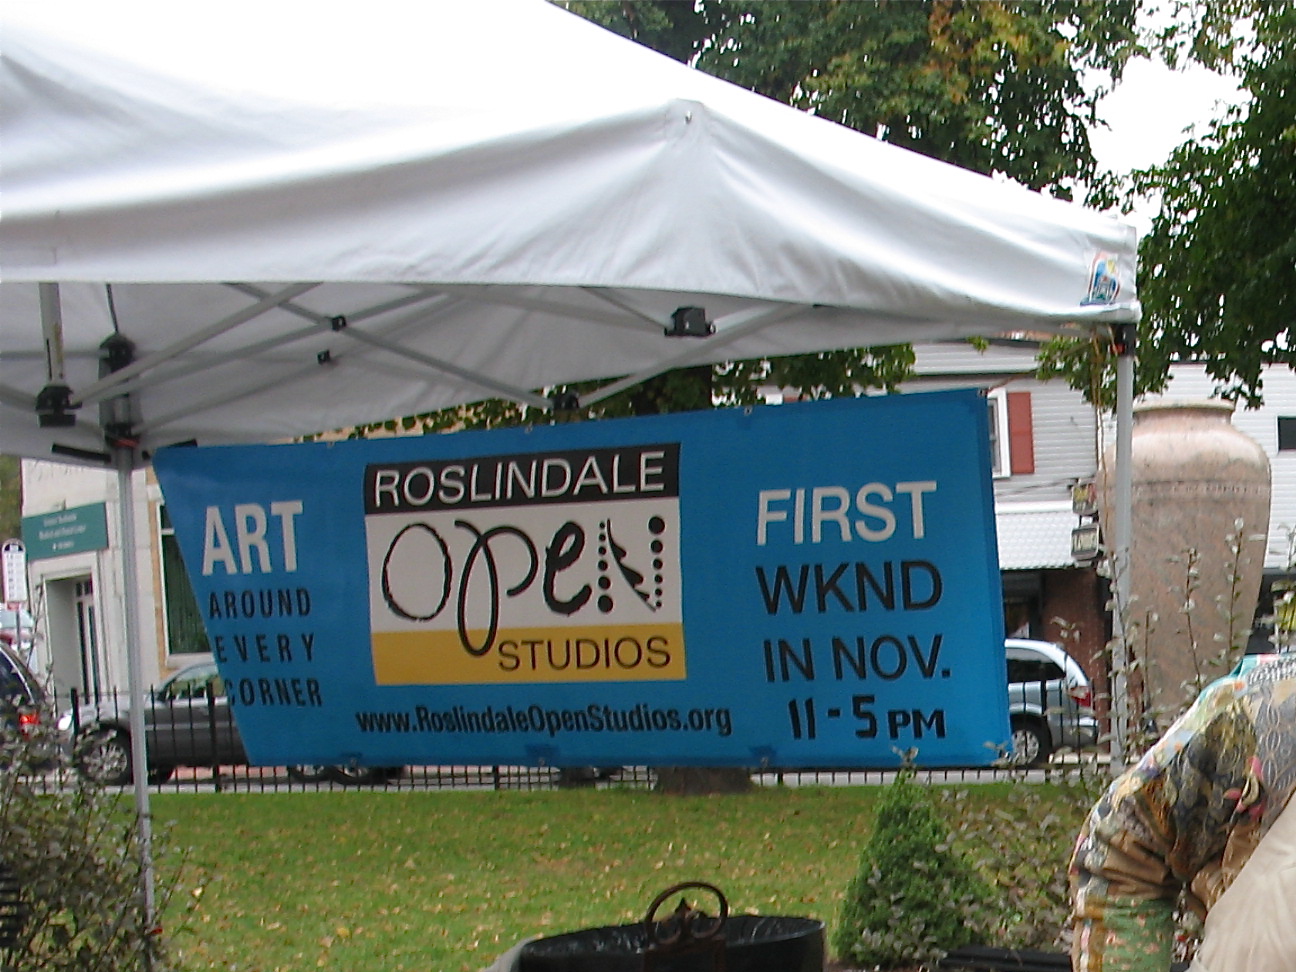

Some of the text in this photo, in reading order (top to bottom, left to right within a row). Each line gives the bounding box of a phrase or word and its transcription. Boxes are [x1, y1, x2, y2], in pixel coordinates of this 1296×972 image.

[375, 451, 666, 508] ROSLINDALE
[756, 480, 937, 546] FIRST
[202, 500, 303, 577] ART
[209, 586, 311, 620] AROUND
[755, 558, 943, 616] WKND
[215, 632, 315, 663] EVERY
[498, 635, 671, 672] STUDIOS
[763, 633, 951, 683] IN NOV.
[356, 703, 732, 738] www.RoslindaleOpenStudios.org
